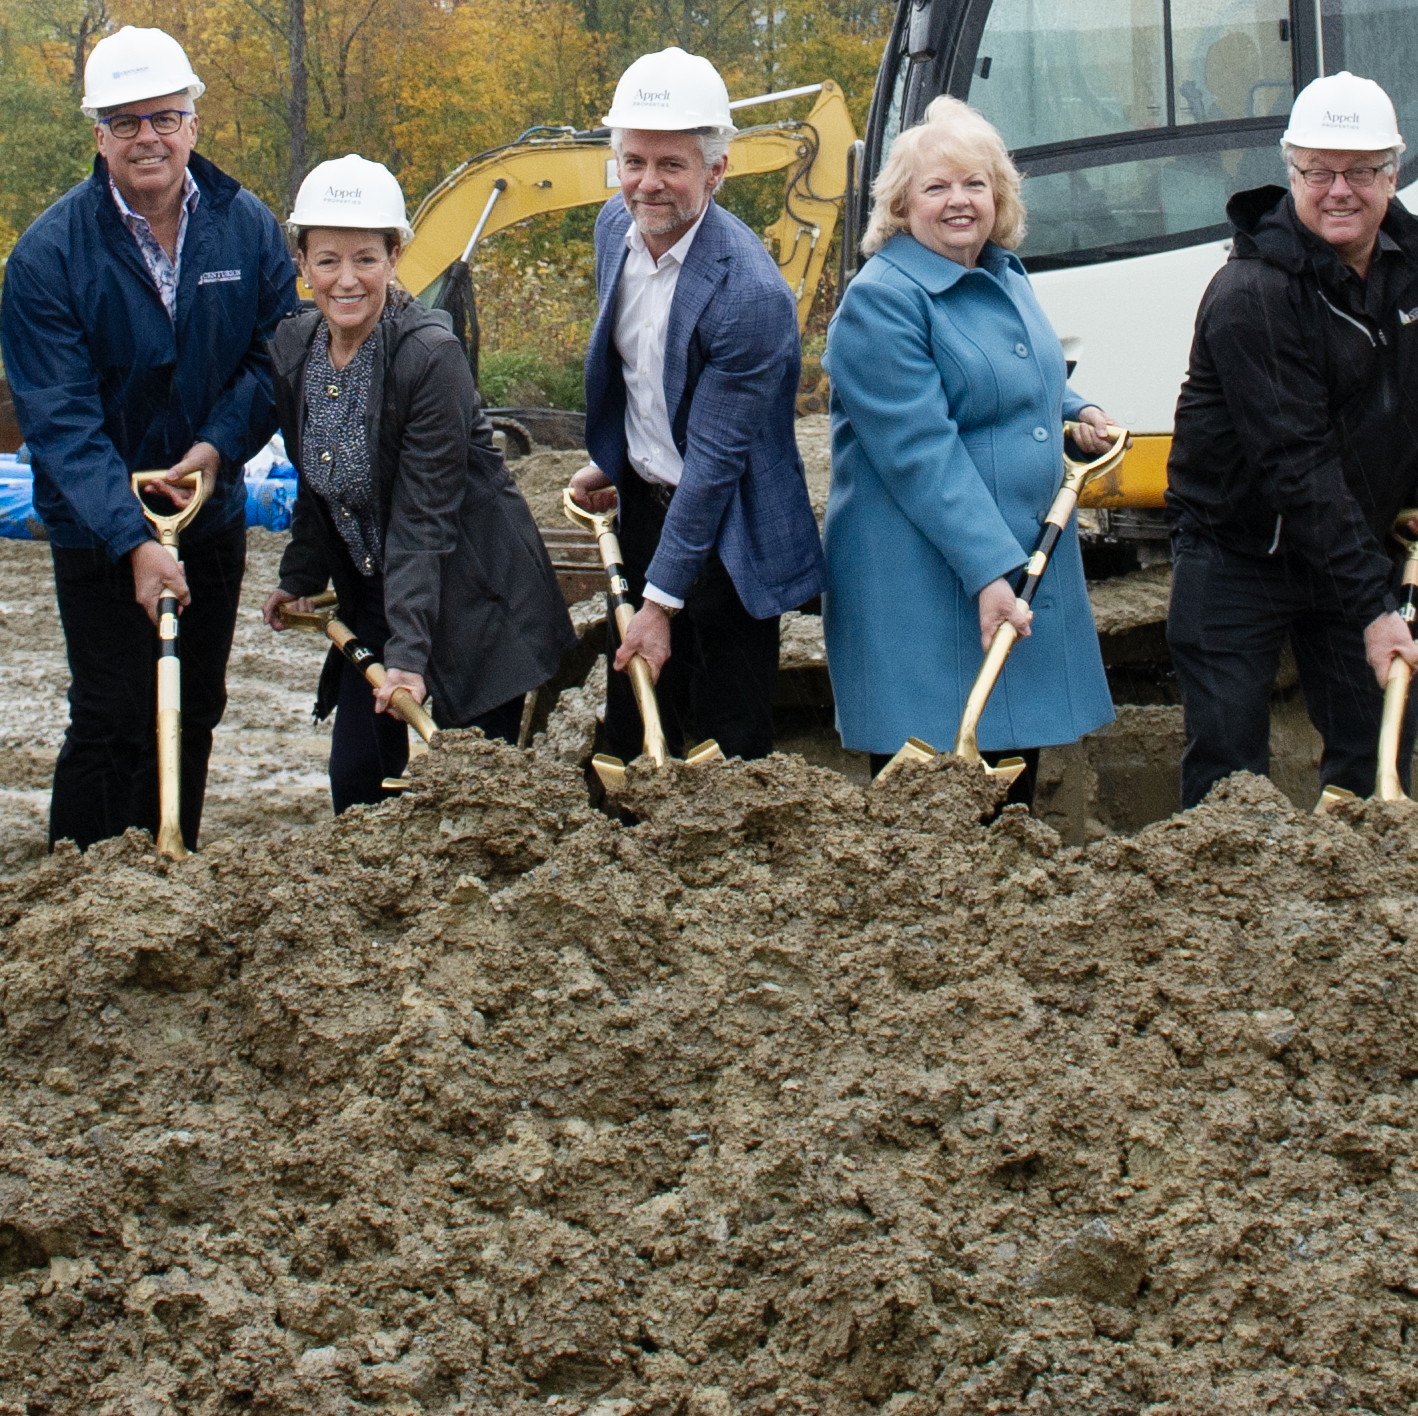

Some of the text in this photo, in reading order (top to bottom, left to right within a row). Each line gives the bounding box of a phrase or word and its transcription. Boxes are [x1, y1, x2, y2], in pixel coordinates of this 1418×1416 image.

[634, 88, 670, 102] Appelt
[1322, 110, 1360, 123] Appelt
[324, 186, 362, 199] Appelt
